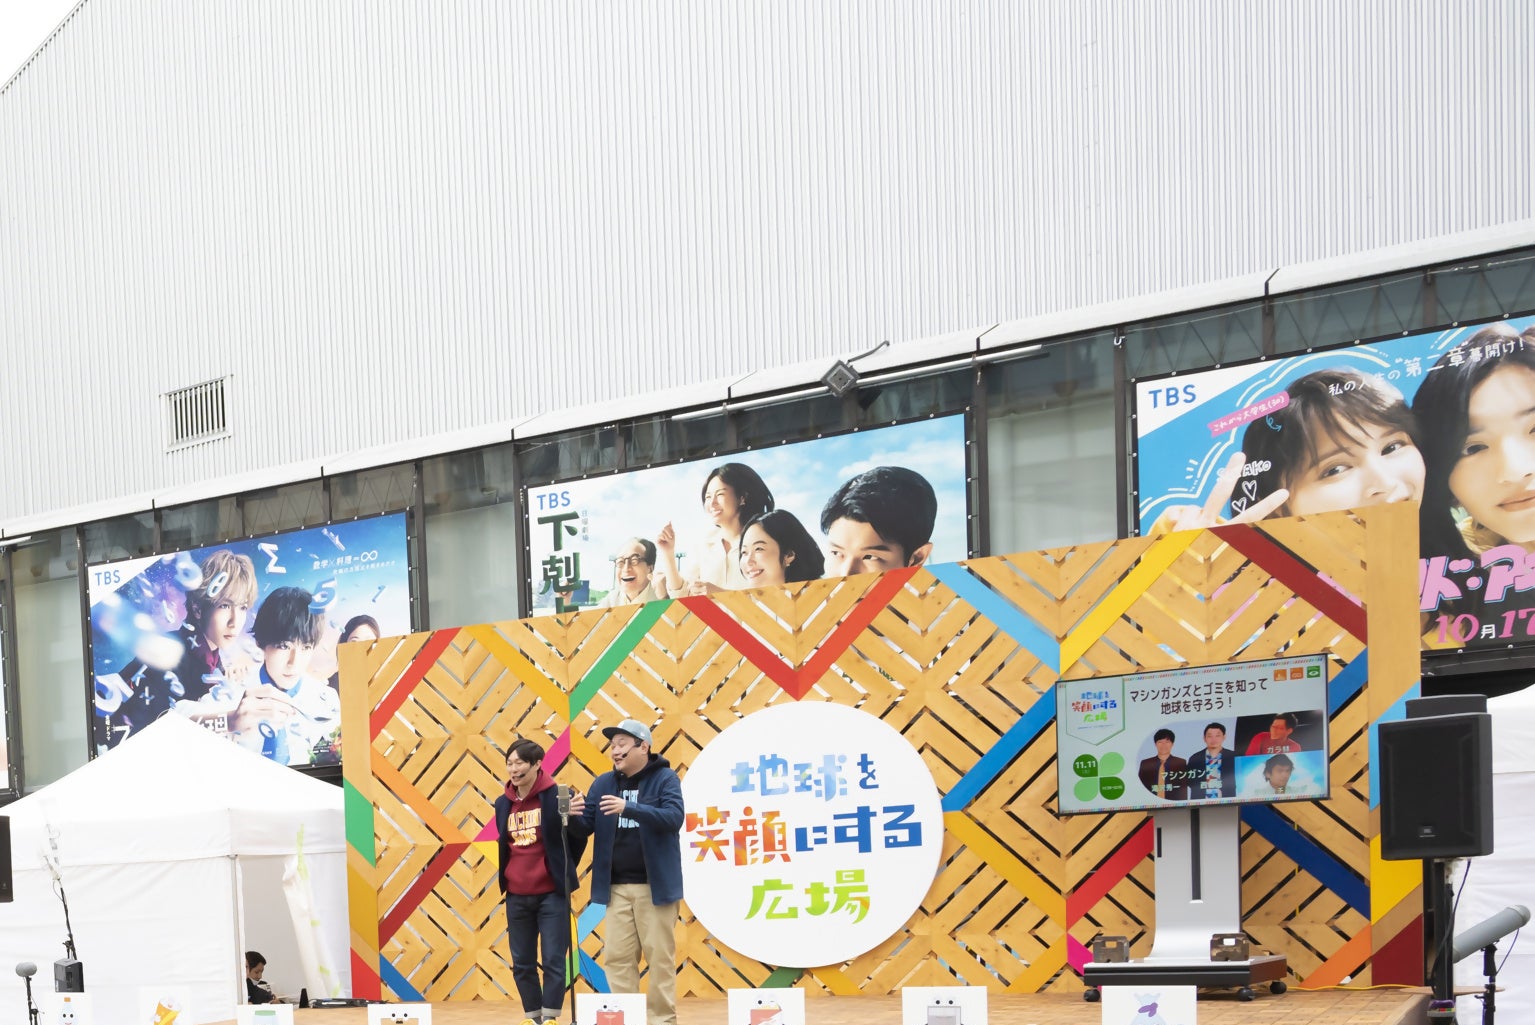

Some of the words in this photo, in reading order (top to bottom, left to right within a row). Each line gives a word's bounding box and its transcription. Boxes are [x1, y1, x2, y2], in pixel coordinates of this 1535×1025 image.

[1149, 384, 1197, 409] TBS
[537, 490, 571, 511] TBS
[95, 571, 121, 586] TBS
[1130, 678, 1268, 702] マシンガンズとゴミを知って
[1161, 697, 1233, 715] 地球を守ろう！
[1075, 760, 1096, 769] 11.11
[730, 753, 880, 801] 地球を
[685, 804, 923, 866] 笑顔にする
[745, 869, 871, 924] 広場
